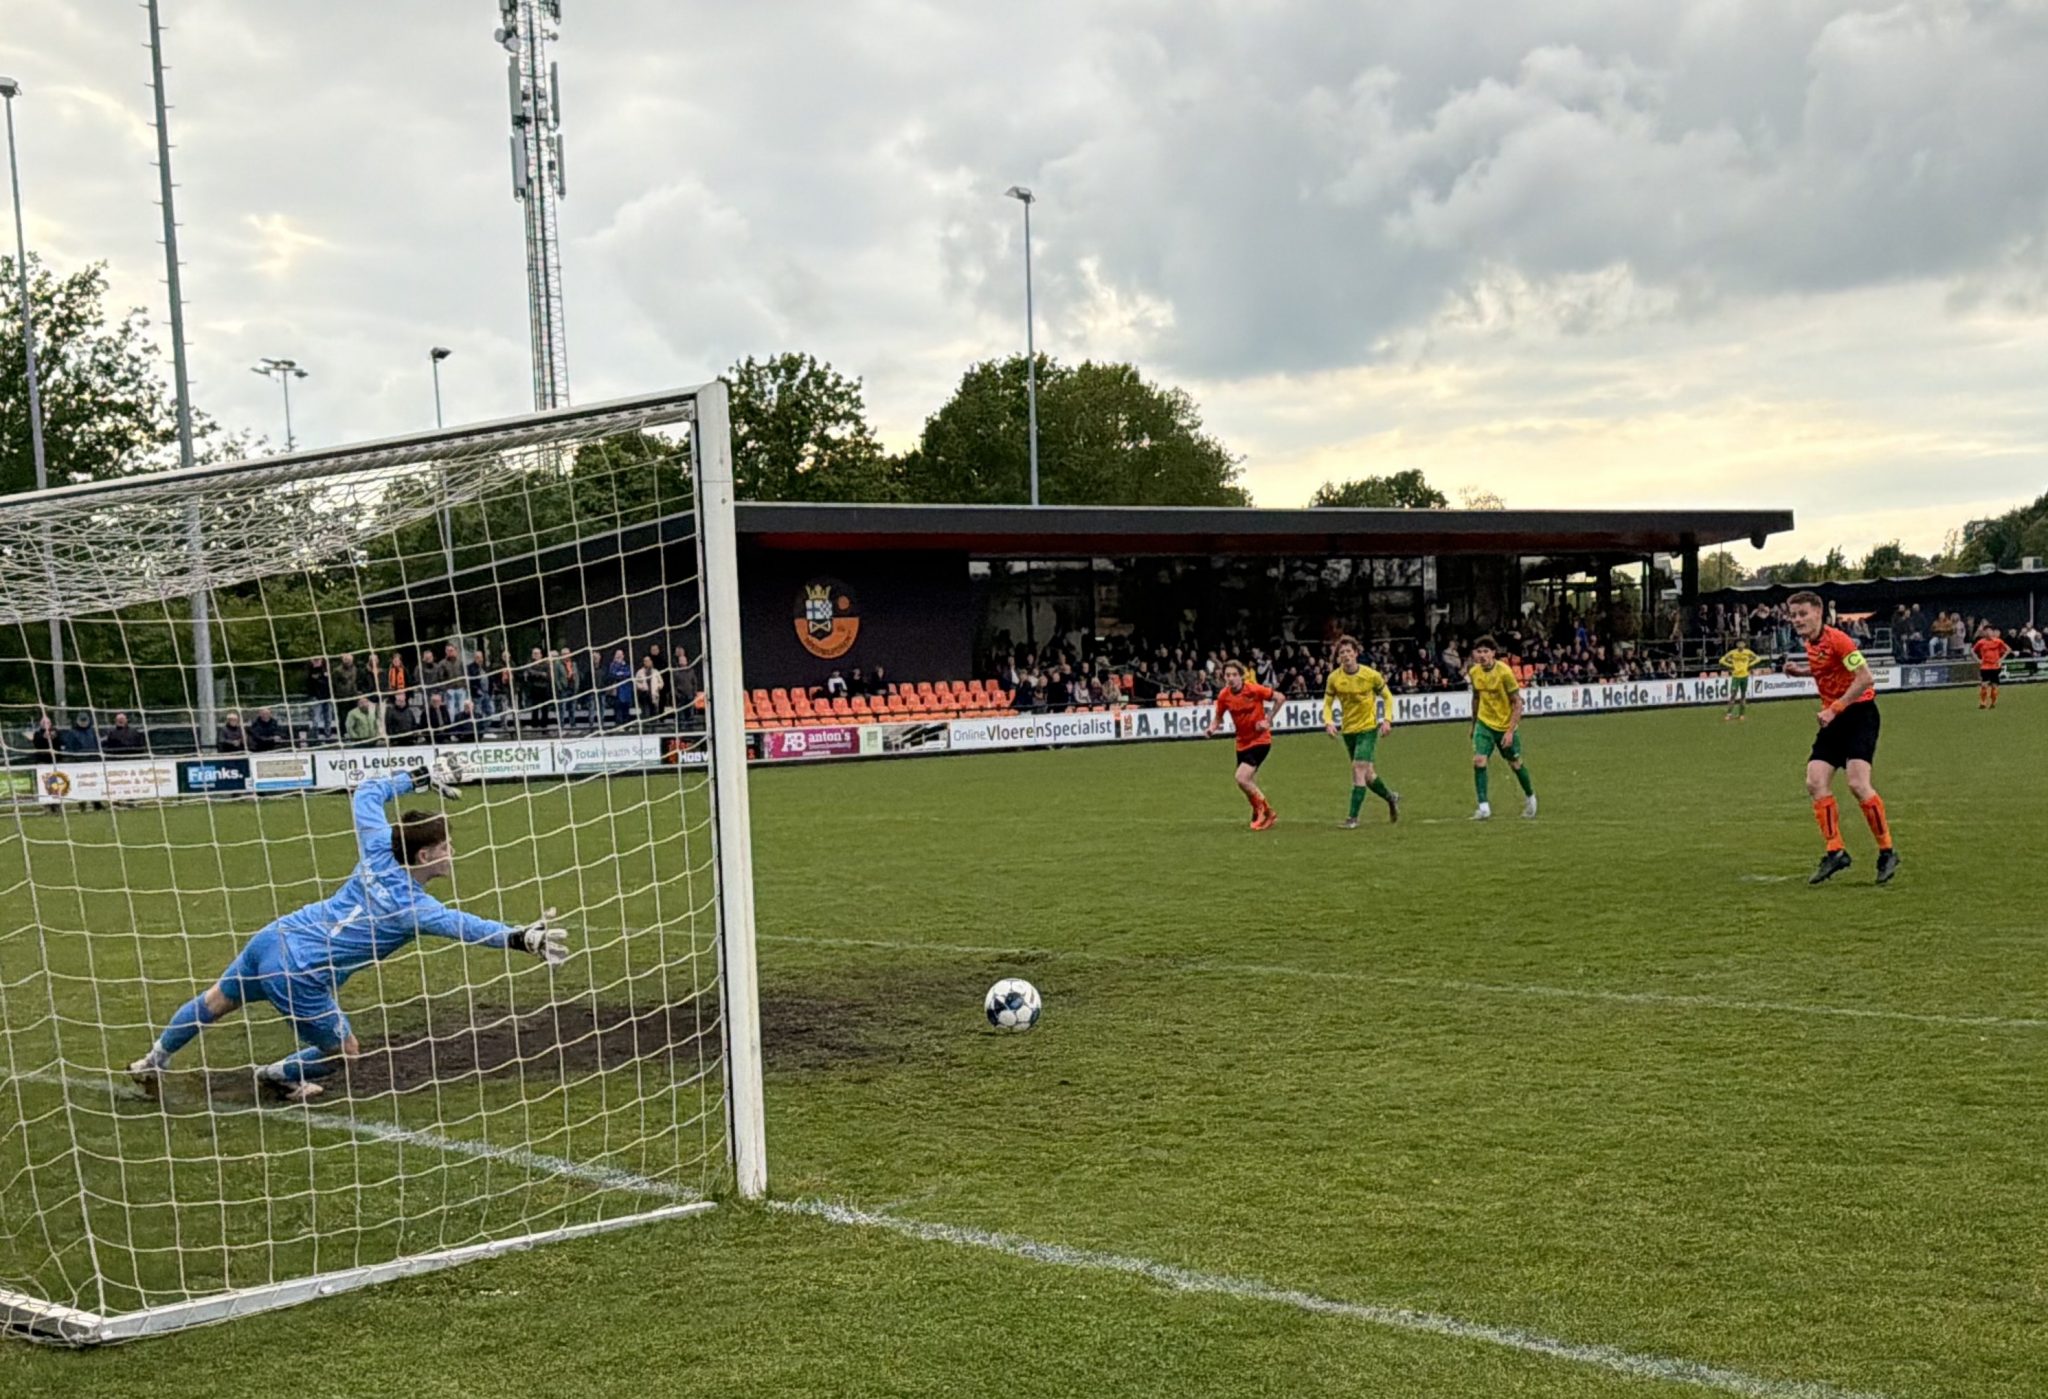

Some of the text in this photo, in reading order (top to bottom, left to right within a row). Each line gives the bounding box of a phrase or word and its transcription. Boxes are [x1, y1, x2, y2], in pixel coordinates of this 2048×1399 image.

[1847, 653, 1862, 667] C
[1582, 687, 1599, 707] A.
[1602, 685, 1649, 706] Heide
[1695, 679, 1729, 700] Heid
[1399, 696, 1451, 719] Heide
[1520, 691, 1553, 712] ide
[1136, 713, 1159, 736] A.
[328, 755, 424, 771] van Leussen
